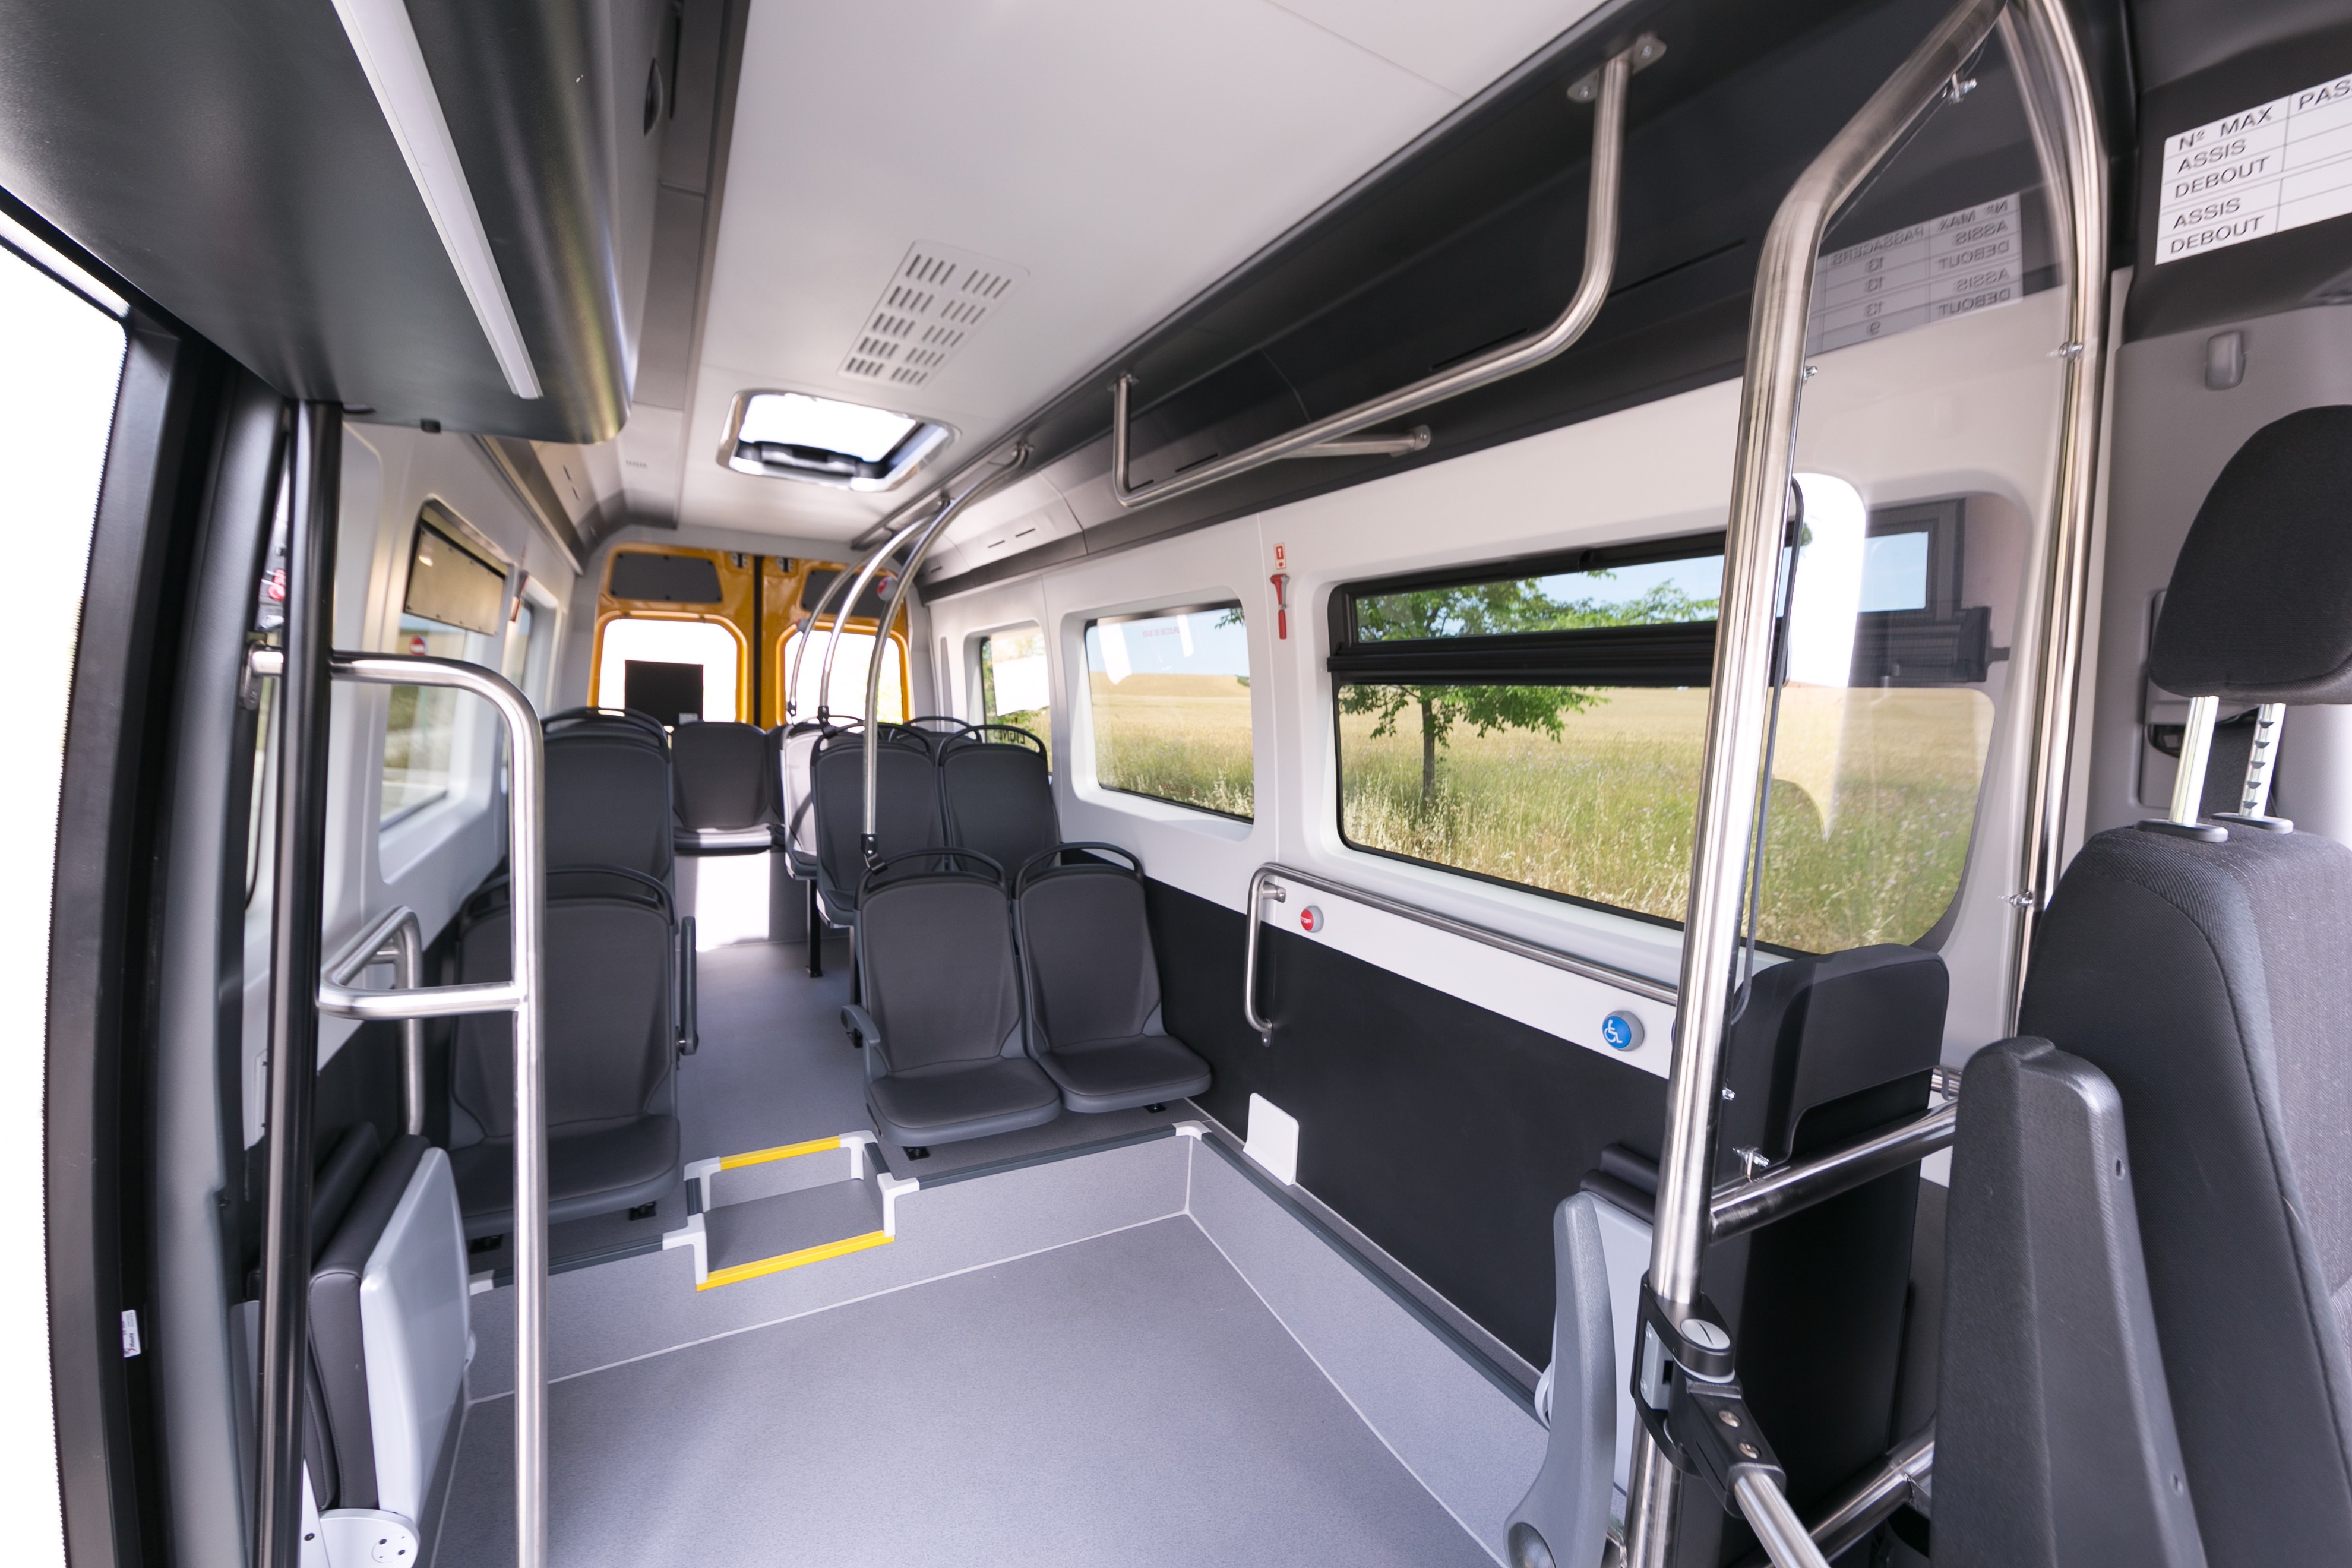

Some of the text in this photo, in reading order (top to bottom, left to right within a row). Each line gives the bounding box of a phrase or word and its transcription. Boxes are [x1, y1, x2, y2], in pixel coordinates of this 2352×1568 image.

[2220, 106, 2274, 138] MAX
[2177, 138, 2247, 174] ASSIS
[2174, 156, 2271, 199] DEBOUT
[2171, 197, 2241, 230] ASSIS
[2170, 215, 2265, 254] DEBOUT
